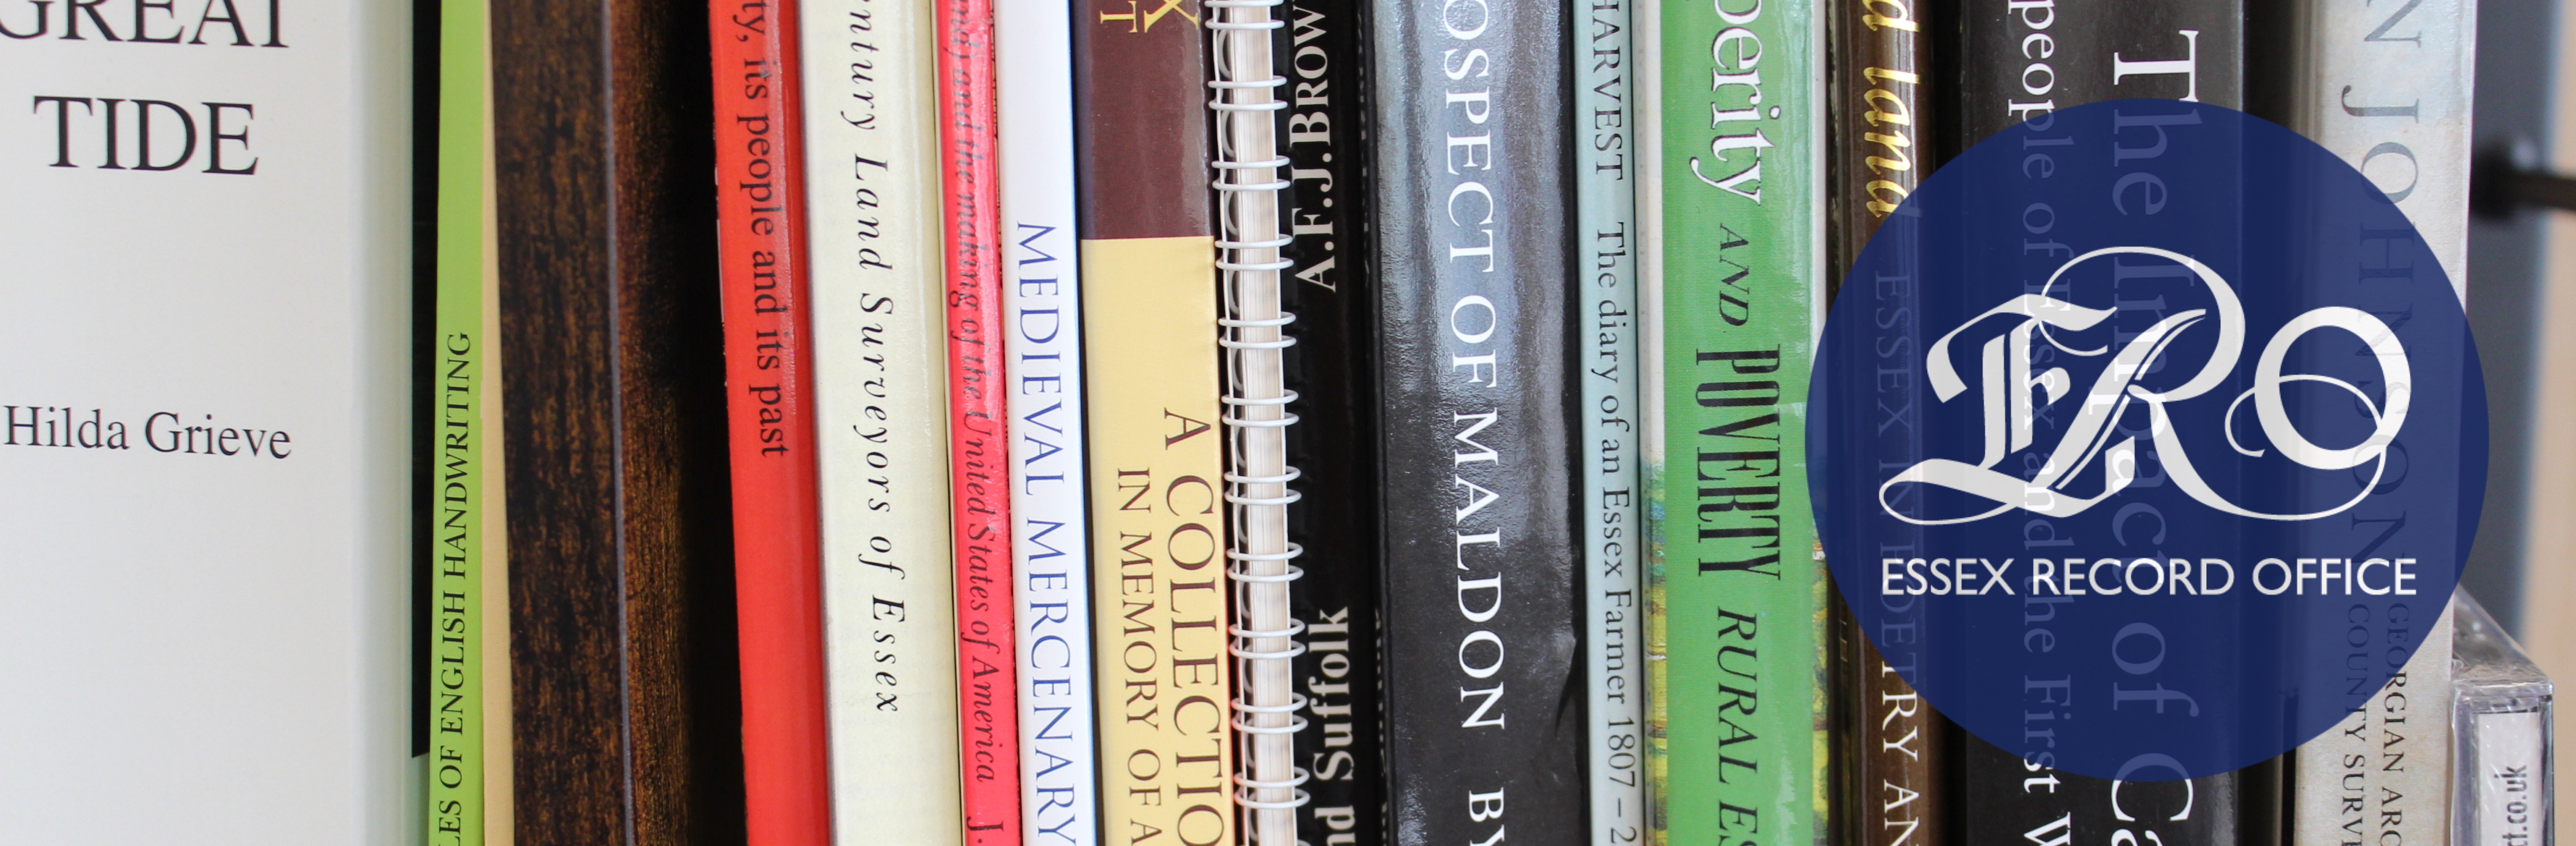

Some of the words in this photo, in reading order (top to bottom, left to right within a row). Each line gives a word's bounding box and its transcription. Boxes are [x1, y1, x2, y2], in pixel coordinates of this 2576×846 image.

[732, 0, 768, 42] ty,
[839, 0, 880, 131] ntury
[943, 0, 981, 59] nd)
[744, 58, 778, 100] its
[952, 68, 984, 130] and
[2007, 0, 2075, 178] people
[2112, 29, 2203, 216] The
[33, 95, 259, 175] TIDE
[737, 113, 784, 235] people
[955, 139, 984, 184] the
[1443, 0, 1494, 273] OSPECT
[1863, 66, 1920, 218] land
[853, 153, 893, 270] Land
[949, 192, 988, 311] making
[1597, 221, 1627, 289] The
[2023, 202, 2075, 259] of
[751, 248, 788, 316] and
[1719, 223, 1750, 327] AND
[754, 329, 790, 371] its
[950, 318, 991, 354] of
[1017, 221, 1065, 496] MEDIEVAL
[1450, 294, 1497, 388] OF
[1590, 299, 1628, 384] diary
[1875, 271, 1912, 438] ESSEX
[2023, 279, 2071, 430] Essex
[2341, 85, 2420, 570] JOHNSON
[748, 383, 789, 458] past
[853, 292, 897, 513] Surveyors
[962, 356, 992, 399] the
[1600, 400, 1630, 432] of
[2087, 254, 2196, 584] Impact
[2, 405, 130, 450] Hilda
[144, 411, 293, 459] Grieve
[443, 332, 471, 581] HANDWRITING
[963, 410, 996, 515] United
[1164, 407, 1211, 450] A
[1601, 436, 1620, 474] an
[1695, 345, 1781, 581] POVERTY
[1117, 467, 1152, 514] IN
[1602, 486, 1630, 577] Essex
[2023, 451, 2076, 550] and
[859, 536, 905, 580] of
[967, 521, 996, 613] States
[1452, 407, 1505, 731] MALDON
[872, 594, 905, 712] Essex
[961, 619, 1001, 655] of
[1120, 531, 1159, 731] MEMORY
[1604, 589, 1632, 704] Farmer
[1880, 540, 1919, 761] POETRY
[2023, 570, 2076, 653] the
[441, 589, 466, 736] ENGLISH
[1027, 516, 1077, 846] MERCENARY
[1166, 474, 1225, 846] COLLECTIO
[1308, 606, 1354, 781] Suffolk
[1717, 606, 1758, 784] RURAL
[2112, 622, 2200, 717] of
[2345, 604, 2370, 742] COUNTY
[2383, 603, 2410, 774] GEORGIAN
[972, 655, 1004, 783] America
[1608, 717, 1636, 788] 1807
[2023, 674, 2071, 793] First
[439, 745, 462, 789] OF
[1127, 748, 1163, 807] OF
[1884, 780, 1920, 846] AN
[967, 816, 1003, 844] J.
[1130, 818, 1163, 845] A
[1468, 787, 1505, 846] BY
[2380, 787, 2404, 846] ARC
